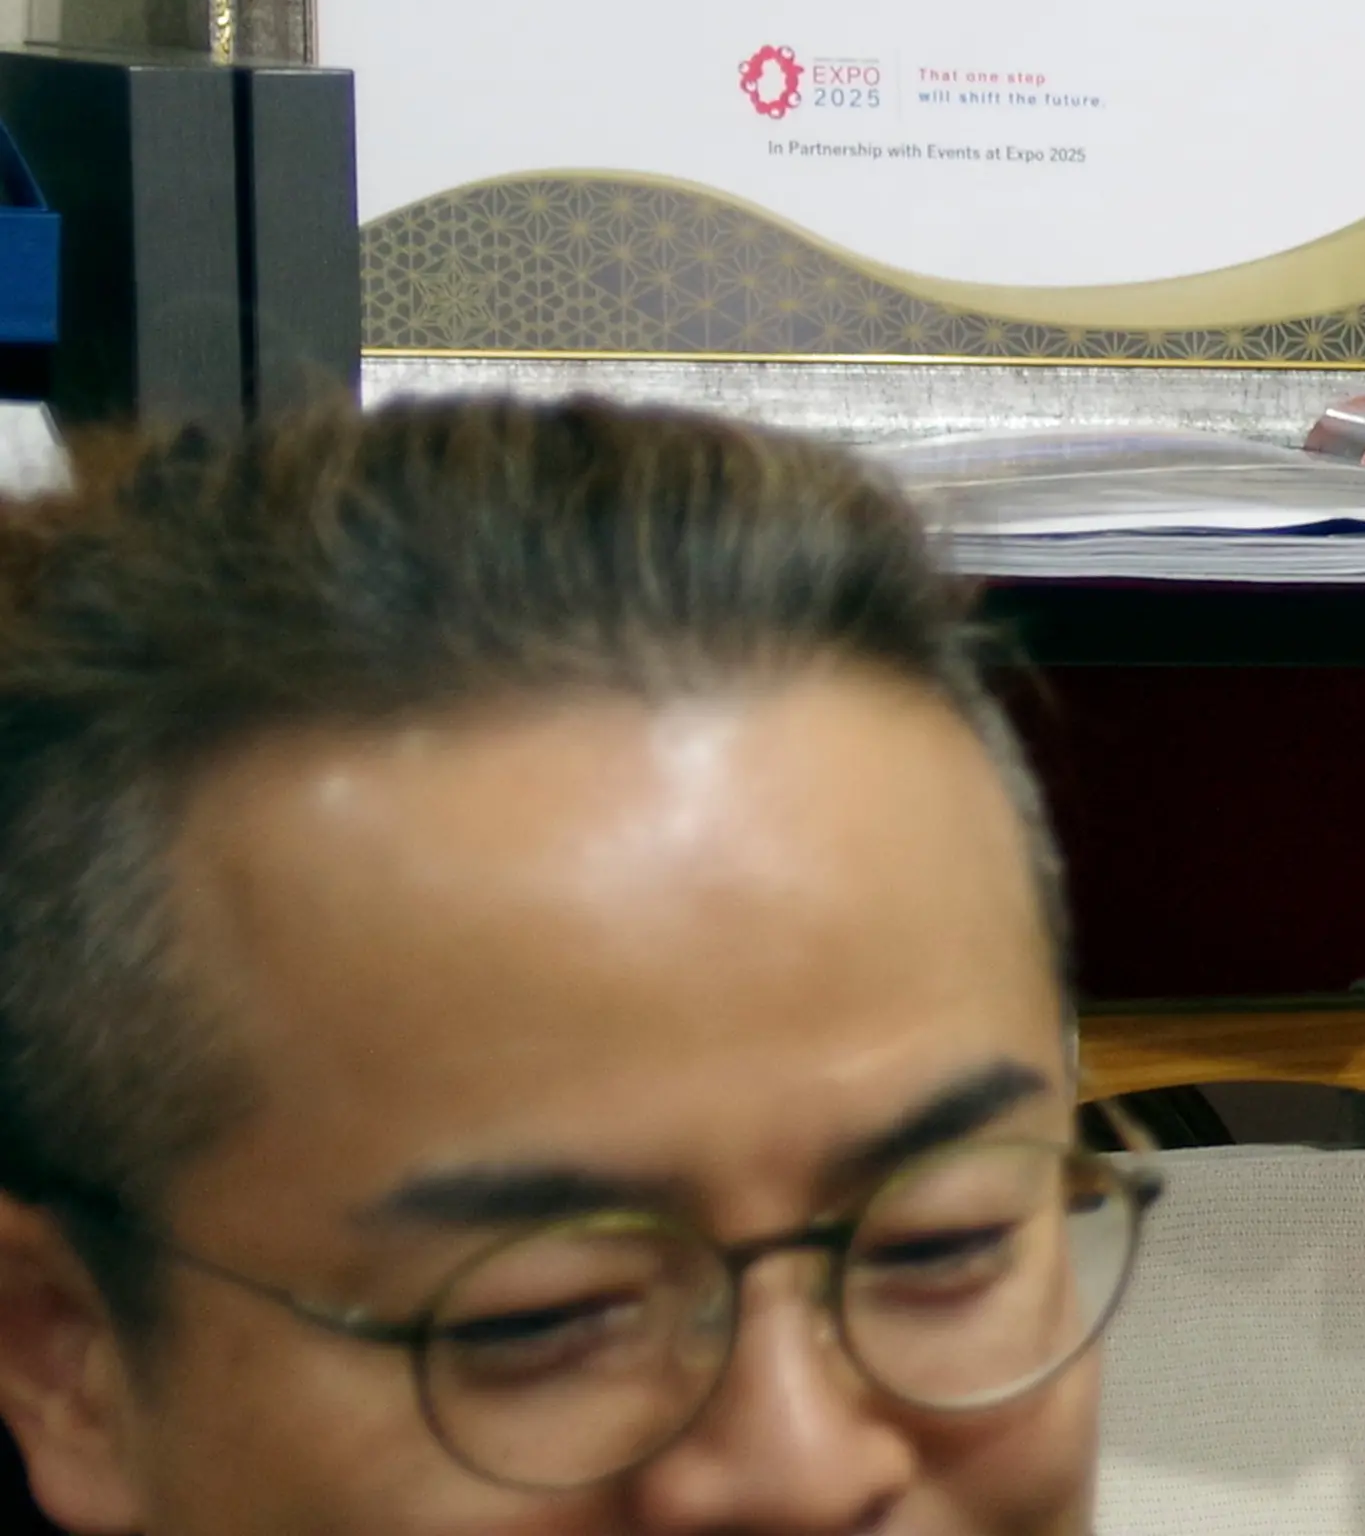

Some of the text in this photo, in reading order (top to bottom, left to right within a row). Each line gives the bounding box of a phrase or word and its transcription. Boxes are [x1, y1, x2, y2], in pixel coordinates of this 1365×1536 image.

[812, 65, 881, 87] EXPO
[918, 67, 1046, 86] That one step
[813, 88, 881, 109] 2025
[918, 90, 951, 104] will
[958, 90, 1001, 106] shift
[1007, 91, 1037, 106] the
[767, 140, 1087, 164] In Partnership with Events at Expo 2025
